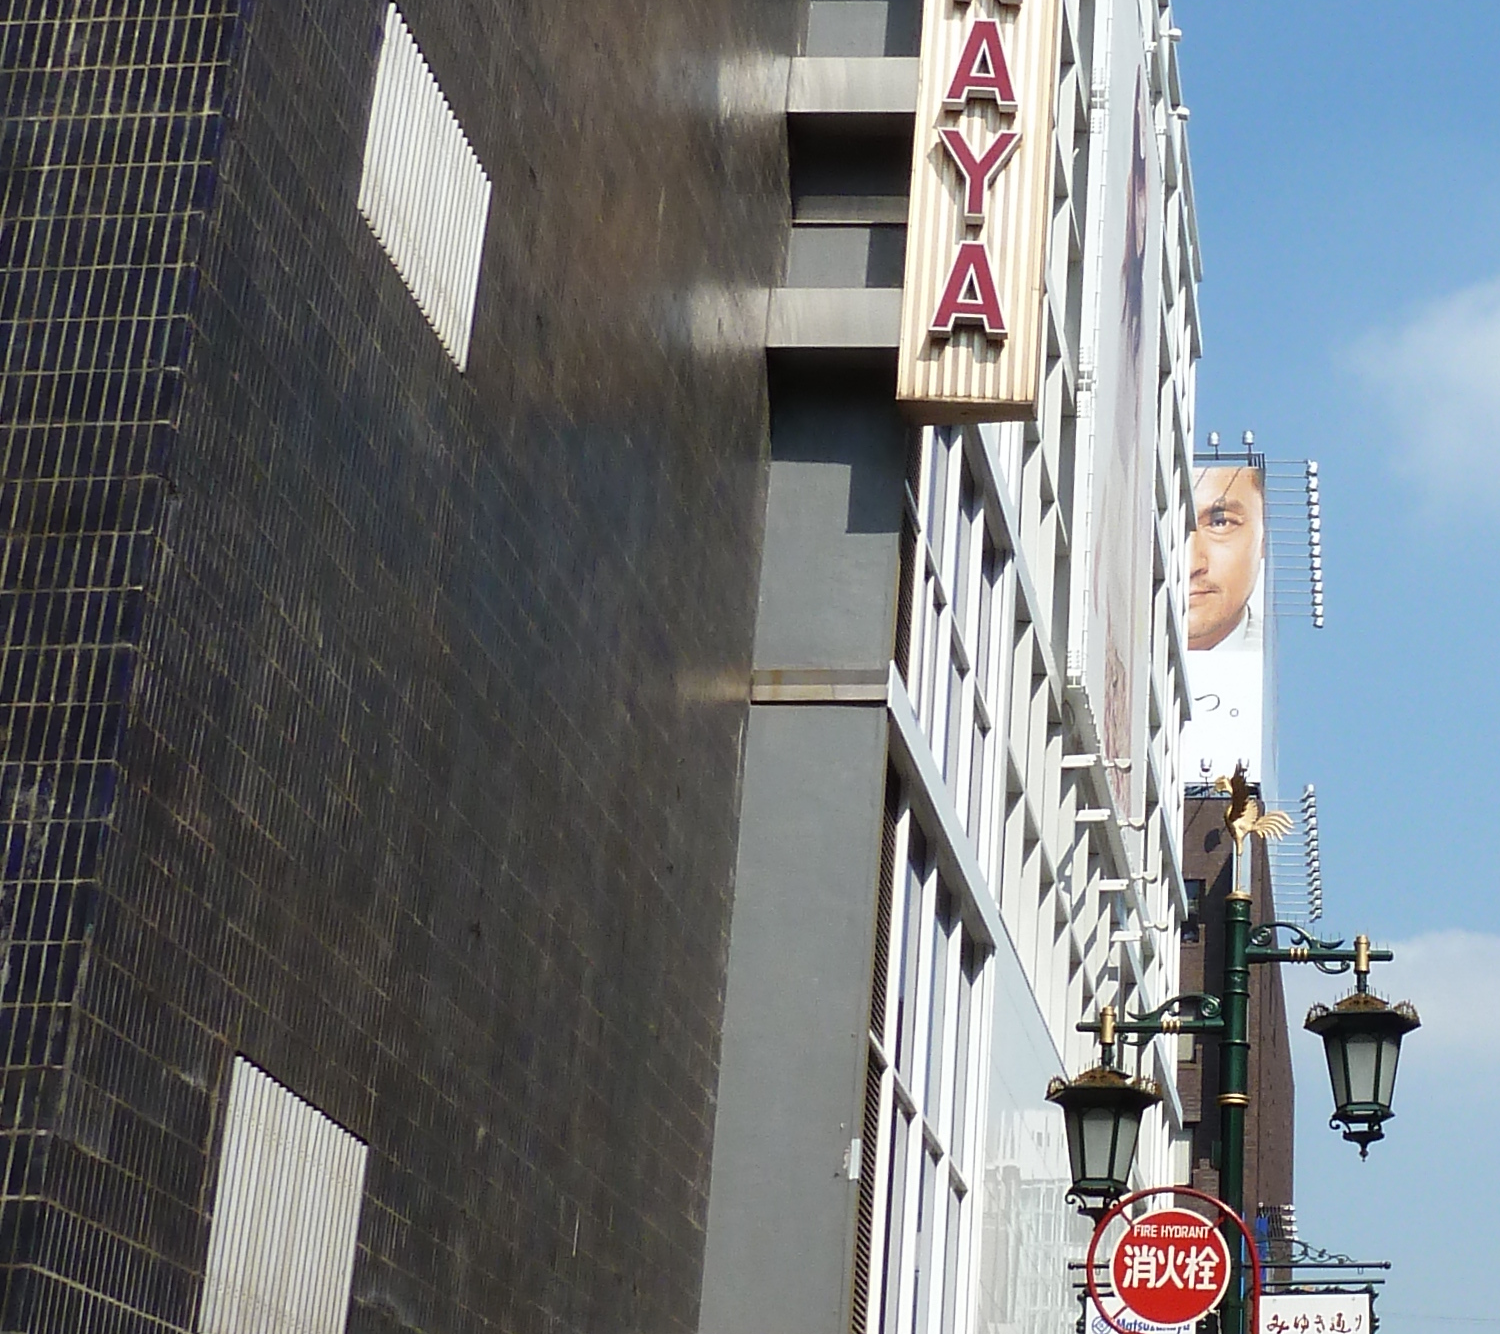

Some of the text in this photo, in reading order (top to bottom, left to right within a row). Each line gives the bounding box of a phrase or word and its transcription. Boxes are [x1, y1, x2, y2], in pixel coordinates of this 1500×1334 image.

[1133, 1224, 1210, 1240] FIRE HYDRANT
[1122, 1244, 1220, 1291] 消火栓
